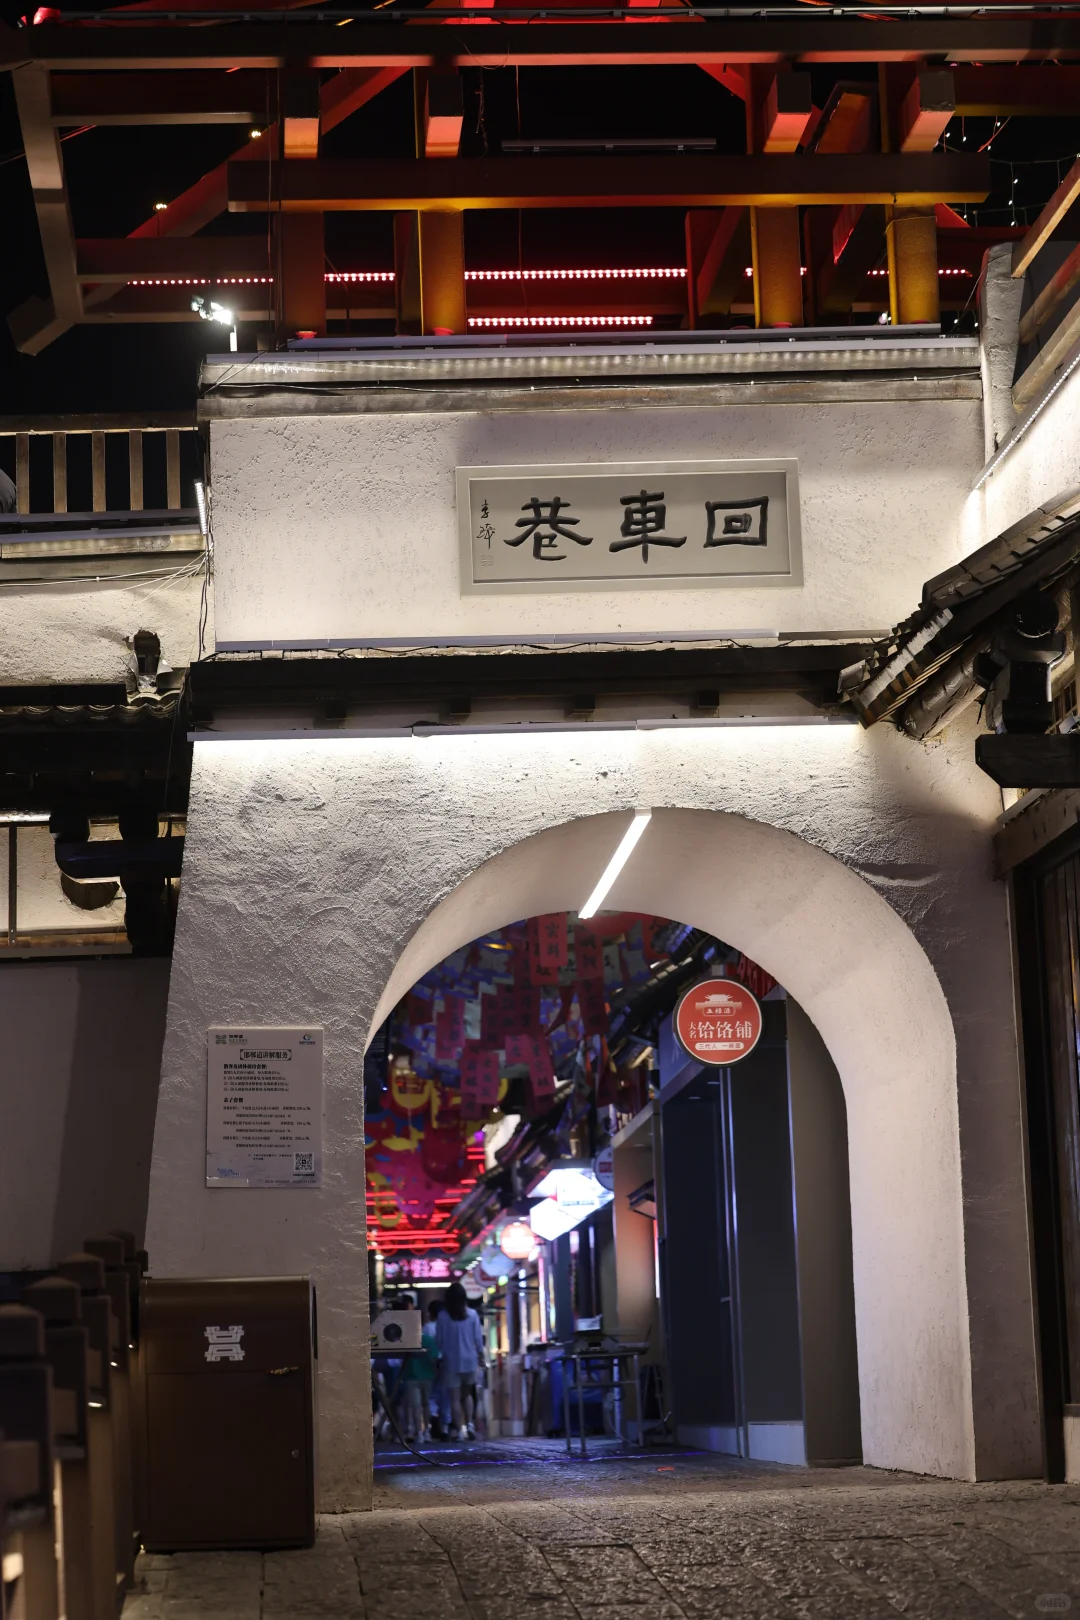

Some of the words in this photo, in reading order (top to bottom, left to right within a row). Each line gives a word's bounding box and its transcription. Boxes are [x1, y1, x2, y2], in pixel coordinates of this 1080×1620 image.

[689, 1021, 697, 1039] 大名
[697, 1021, 752, 1039] 饸饹铺
